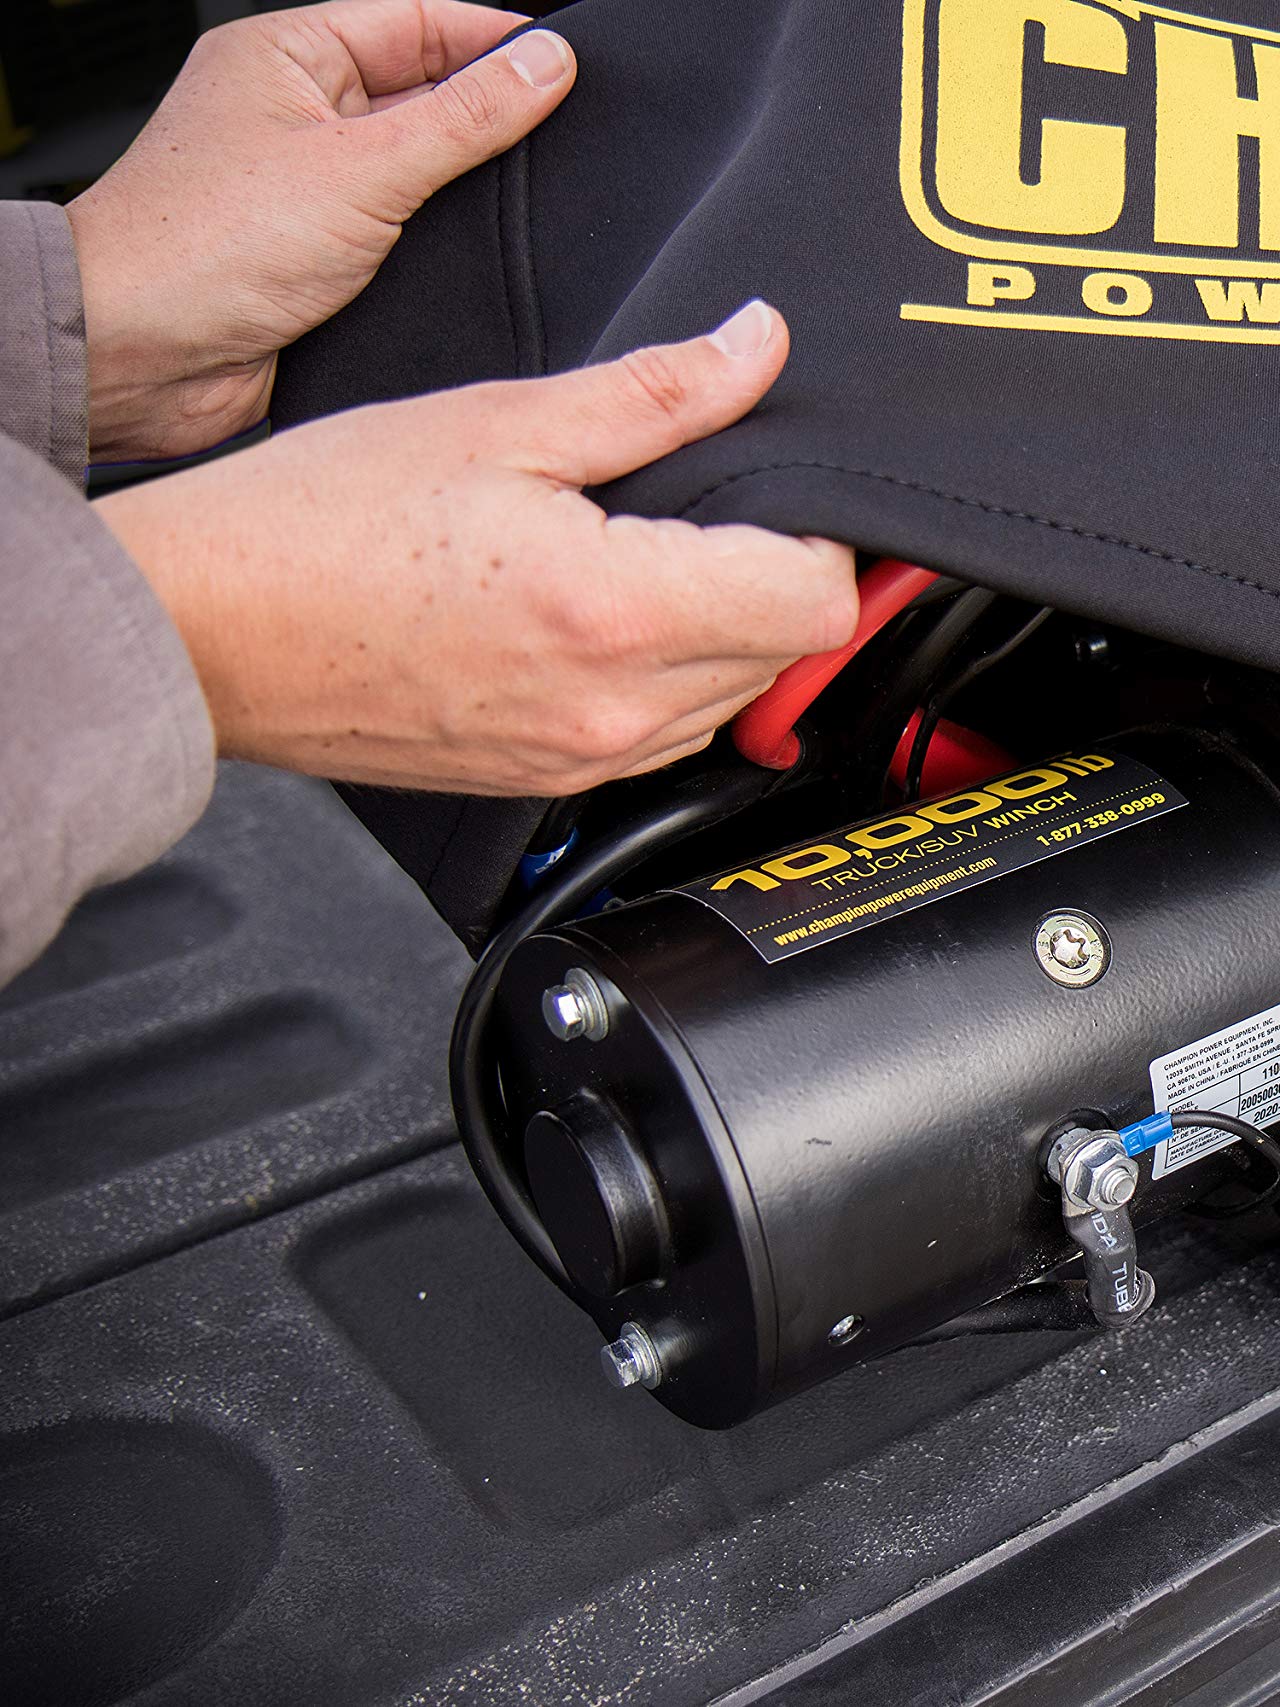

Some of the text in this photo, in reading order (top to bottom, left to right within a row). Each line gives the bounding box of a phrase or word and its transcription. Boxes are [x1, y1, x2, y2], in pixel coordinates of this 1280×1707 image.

[1036, 792, 1166, 847] 1-877-338-0999
[811, 791, 1077, 891] TRUCK/SUV WINCH
[774, 856, 997, 946] www.championpowerequipment.com
[1164, 1051, 1198, 1071] CHAMPION
[1199, 1040, 1223, 1056] POWER
[1166, 1069, 1184, 1080] 12039
[1184, 1060, 1204, 1072] SMITH
[1205, 1047, 1232, 1063] AVENUE
[1236, 1036, 1257, 1050] SANTA
[1257, 1031, 1266, 1040] FE
[1166, 1082, 1177, 1091] CA
[1198, 1066, 1212, 1077] USA
[1167, 1088, 1187, 1100] MADE
[1196, 1075, 1216, 1088] CHINA
[1252, 1052, 1262, 1061] EN
[1172, 1101, 1194, 1114] MODEL
[1170, 1132, 1212, 1154] MANUFACTURE
[1180, 1131, 1188, 1139] DE
[1170, 1152, 1184, 1162] DATE
